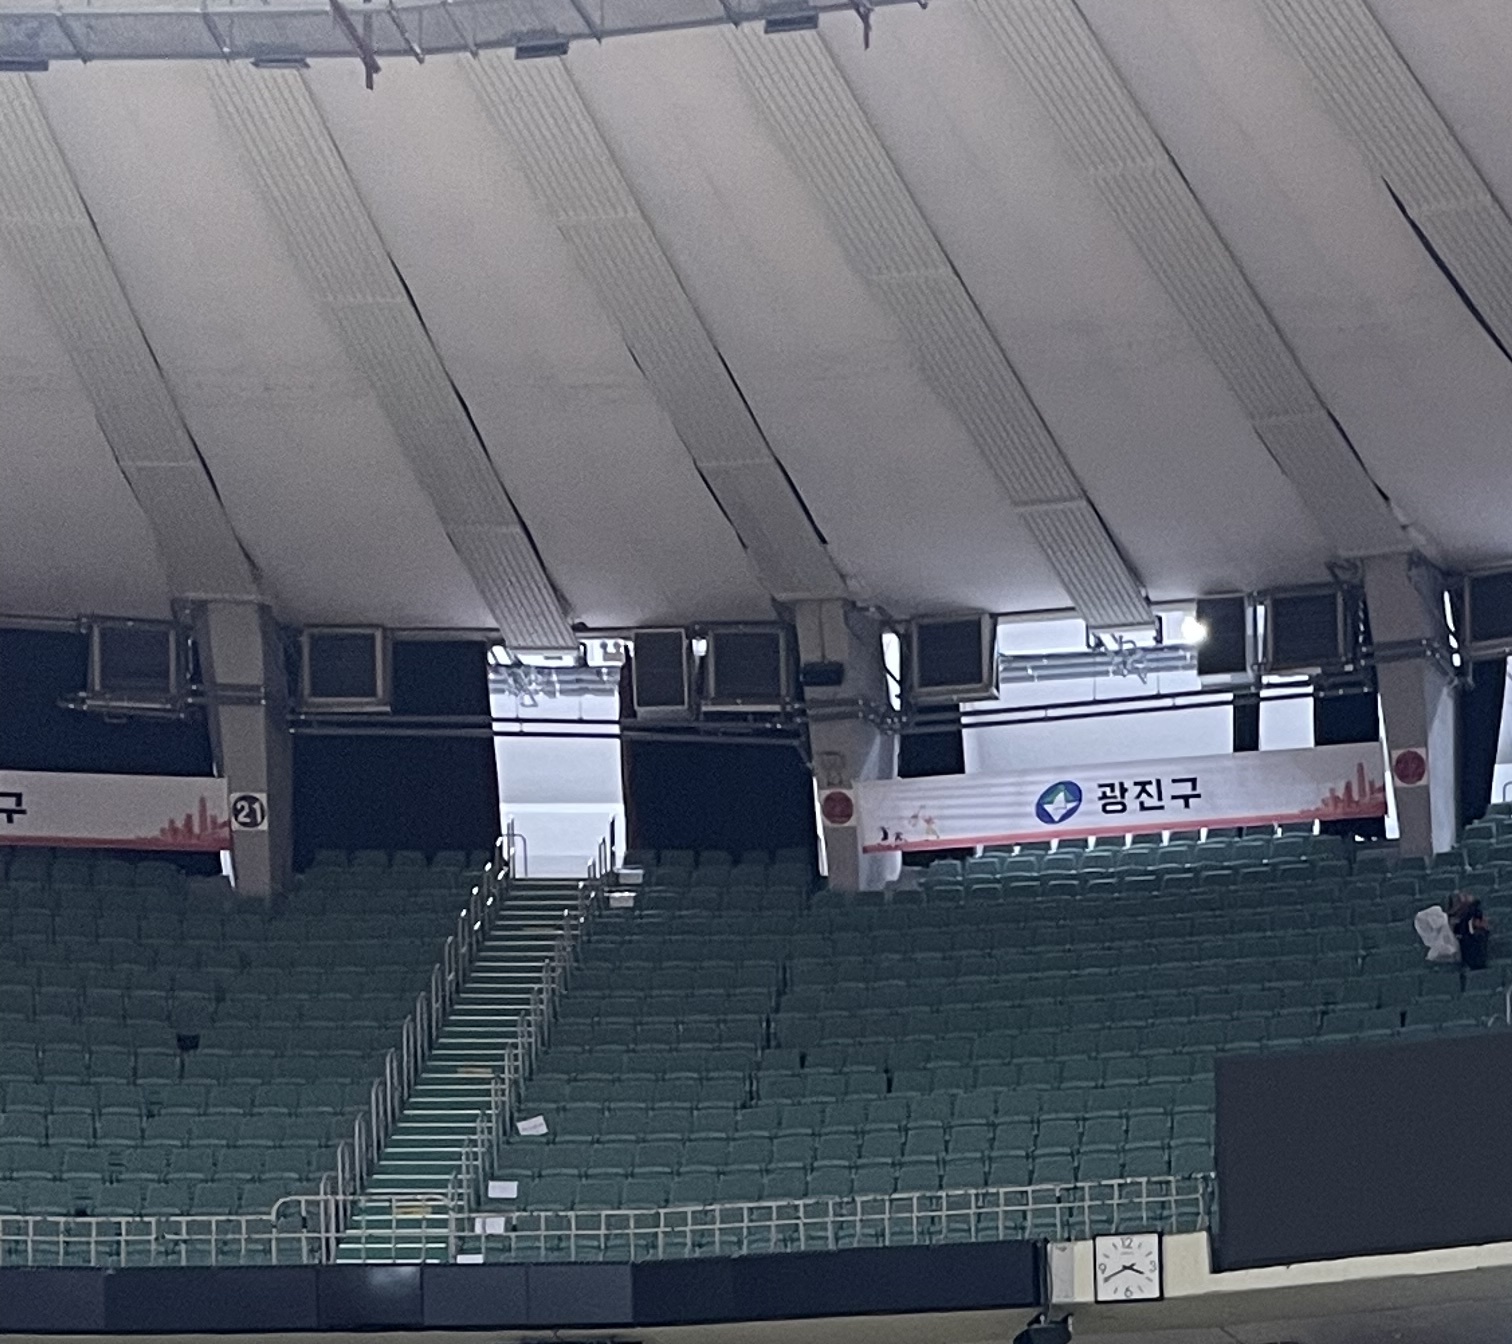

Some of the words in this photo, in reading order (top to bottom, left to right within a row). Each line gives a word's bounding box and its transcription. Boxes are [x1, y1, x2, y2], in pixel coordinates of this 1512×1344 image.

[1097, 777, 1202, 815] 광진구
[236, 801, 262, 823] 21
[1120, 1237, 1133, 1249] 12
[1098, 1262, 1107, 1275] 9
[1149, 1260, 1157, 1273] 3
[1124, 1286, 1133, 1298] 6
